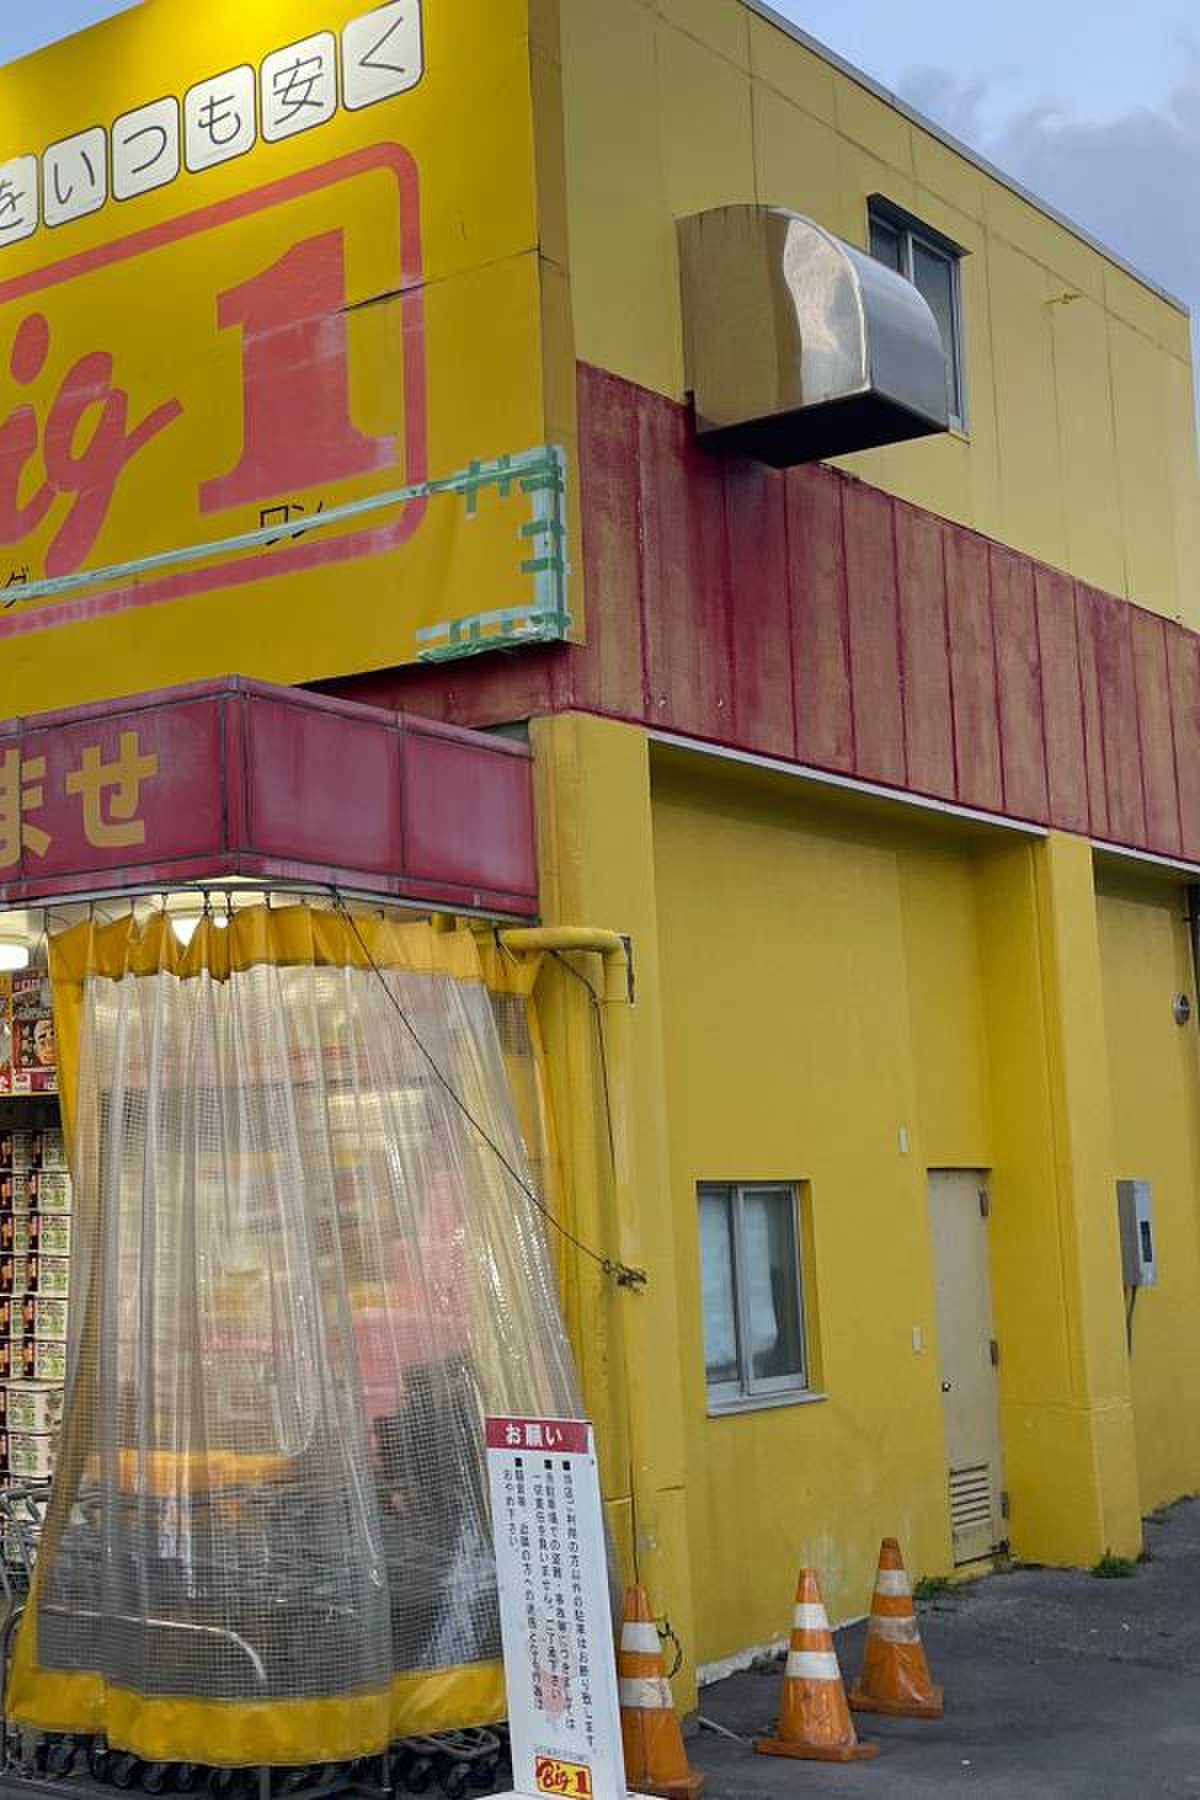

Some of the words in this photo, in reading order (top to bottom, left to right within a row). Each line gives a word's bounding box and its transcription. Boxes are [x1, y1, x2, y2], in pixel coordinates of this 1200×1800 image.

[200, 227, 397, 515] 1
[505, 1423, 563, 1446] お願い
